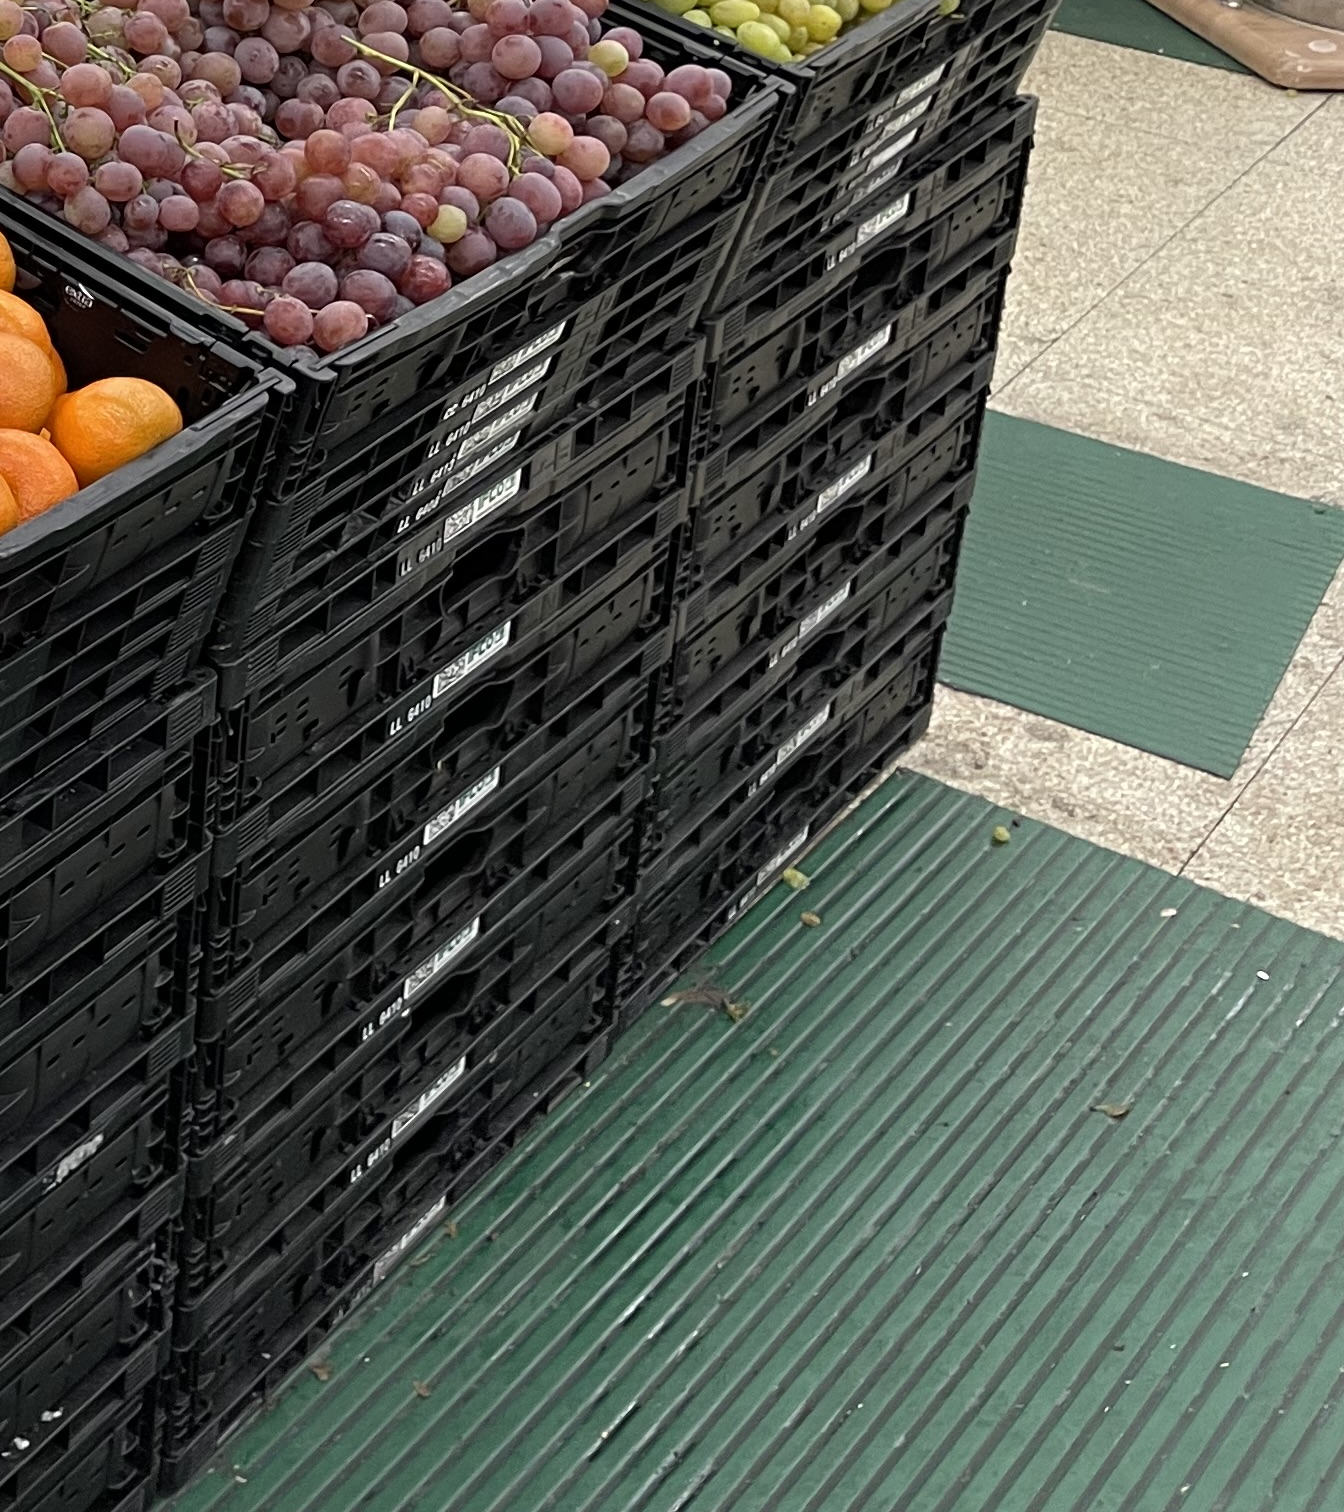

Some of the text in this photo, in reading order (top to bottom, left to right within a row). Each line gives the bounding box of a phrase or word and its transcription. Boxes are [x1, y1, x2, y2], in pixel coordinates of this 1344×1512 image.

[400, 538, 442, 576] LL 6410
[390, 695, 431, 735] LL 6410
[379, 845, 420, 888] LL 6410
